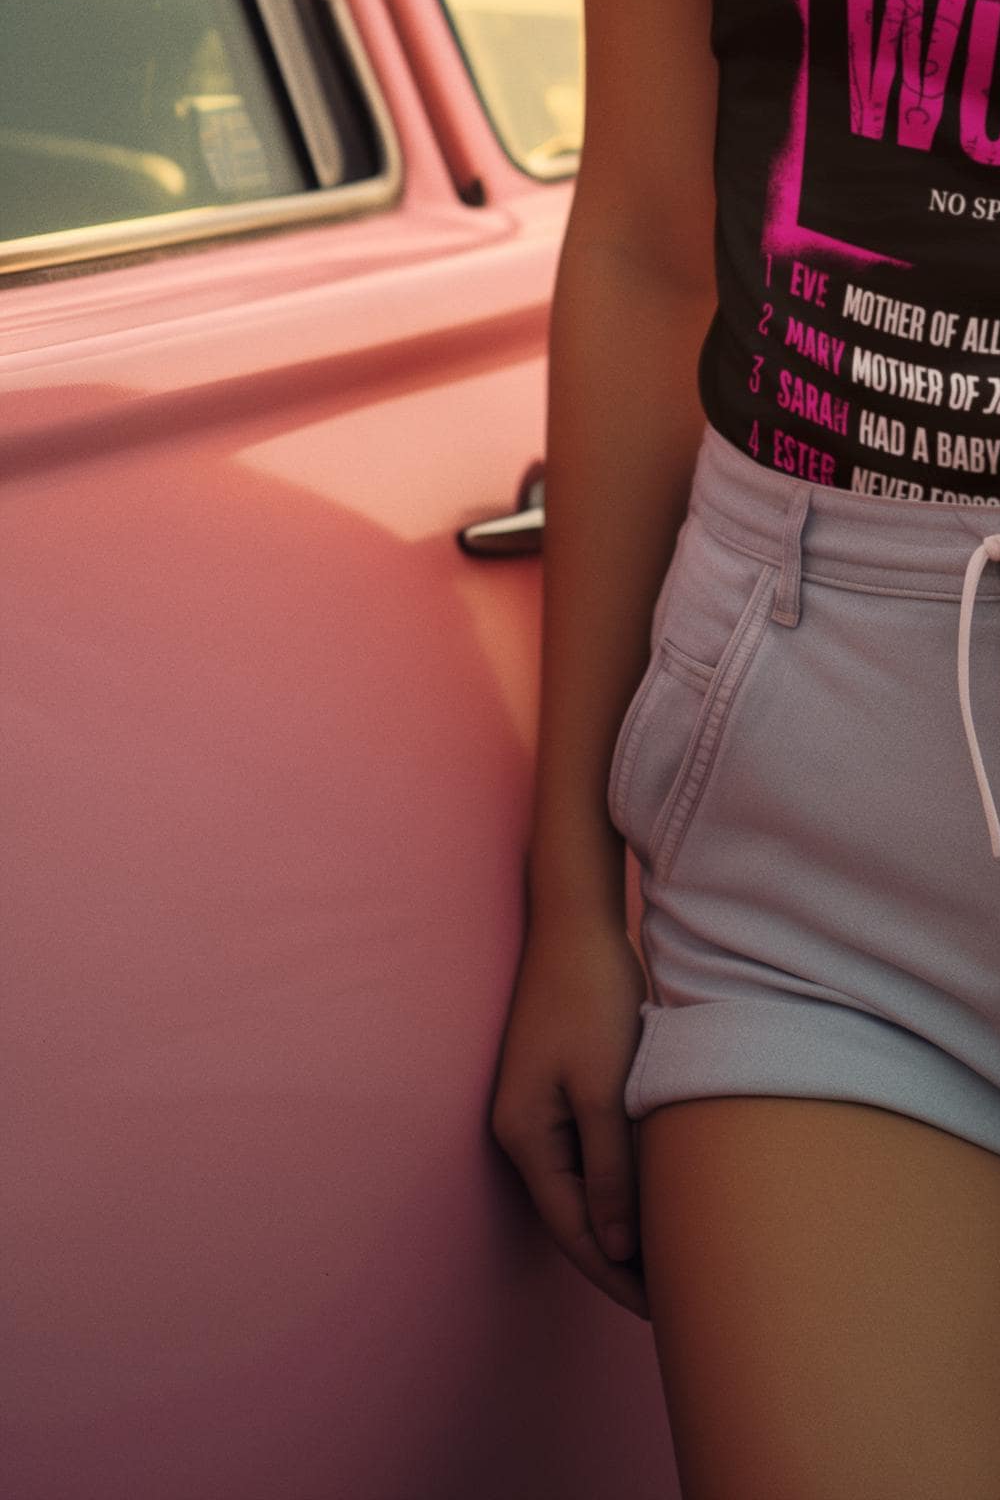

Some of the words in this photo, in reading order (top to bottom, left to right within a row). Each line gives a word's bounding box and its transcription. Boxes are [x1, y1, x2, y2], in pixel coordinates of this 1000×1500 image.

[928, 188, 966, 216] NO
[765, 252, 773, 288] 1
[790, 260, 830, 308] EVE
[842, 283, 926, 342] MOTHER
[929, 311, 960, 348] OF
[758, 302, 774, 336] 2
[784, 315, 846, 376] MARY
[851, 346, 943, 407] MOTHER
[948, 372, 980, 412] OF
[747, 419, 761, 458] 4
[773, 428, 836, 487] ESTER
[749, 355, 765, 393] 3
[777, 369, 849, 436] SARAH
[858, 409, 906, 457] HAD
[912, 427, 930, 464] A
